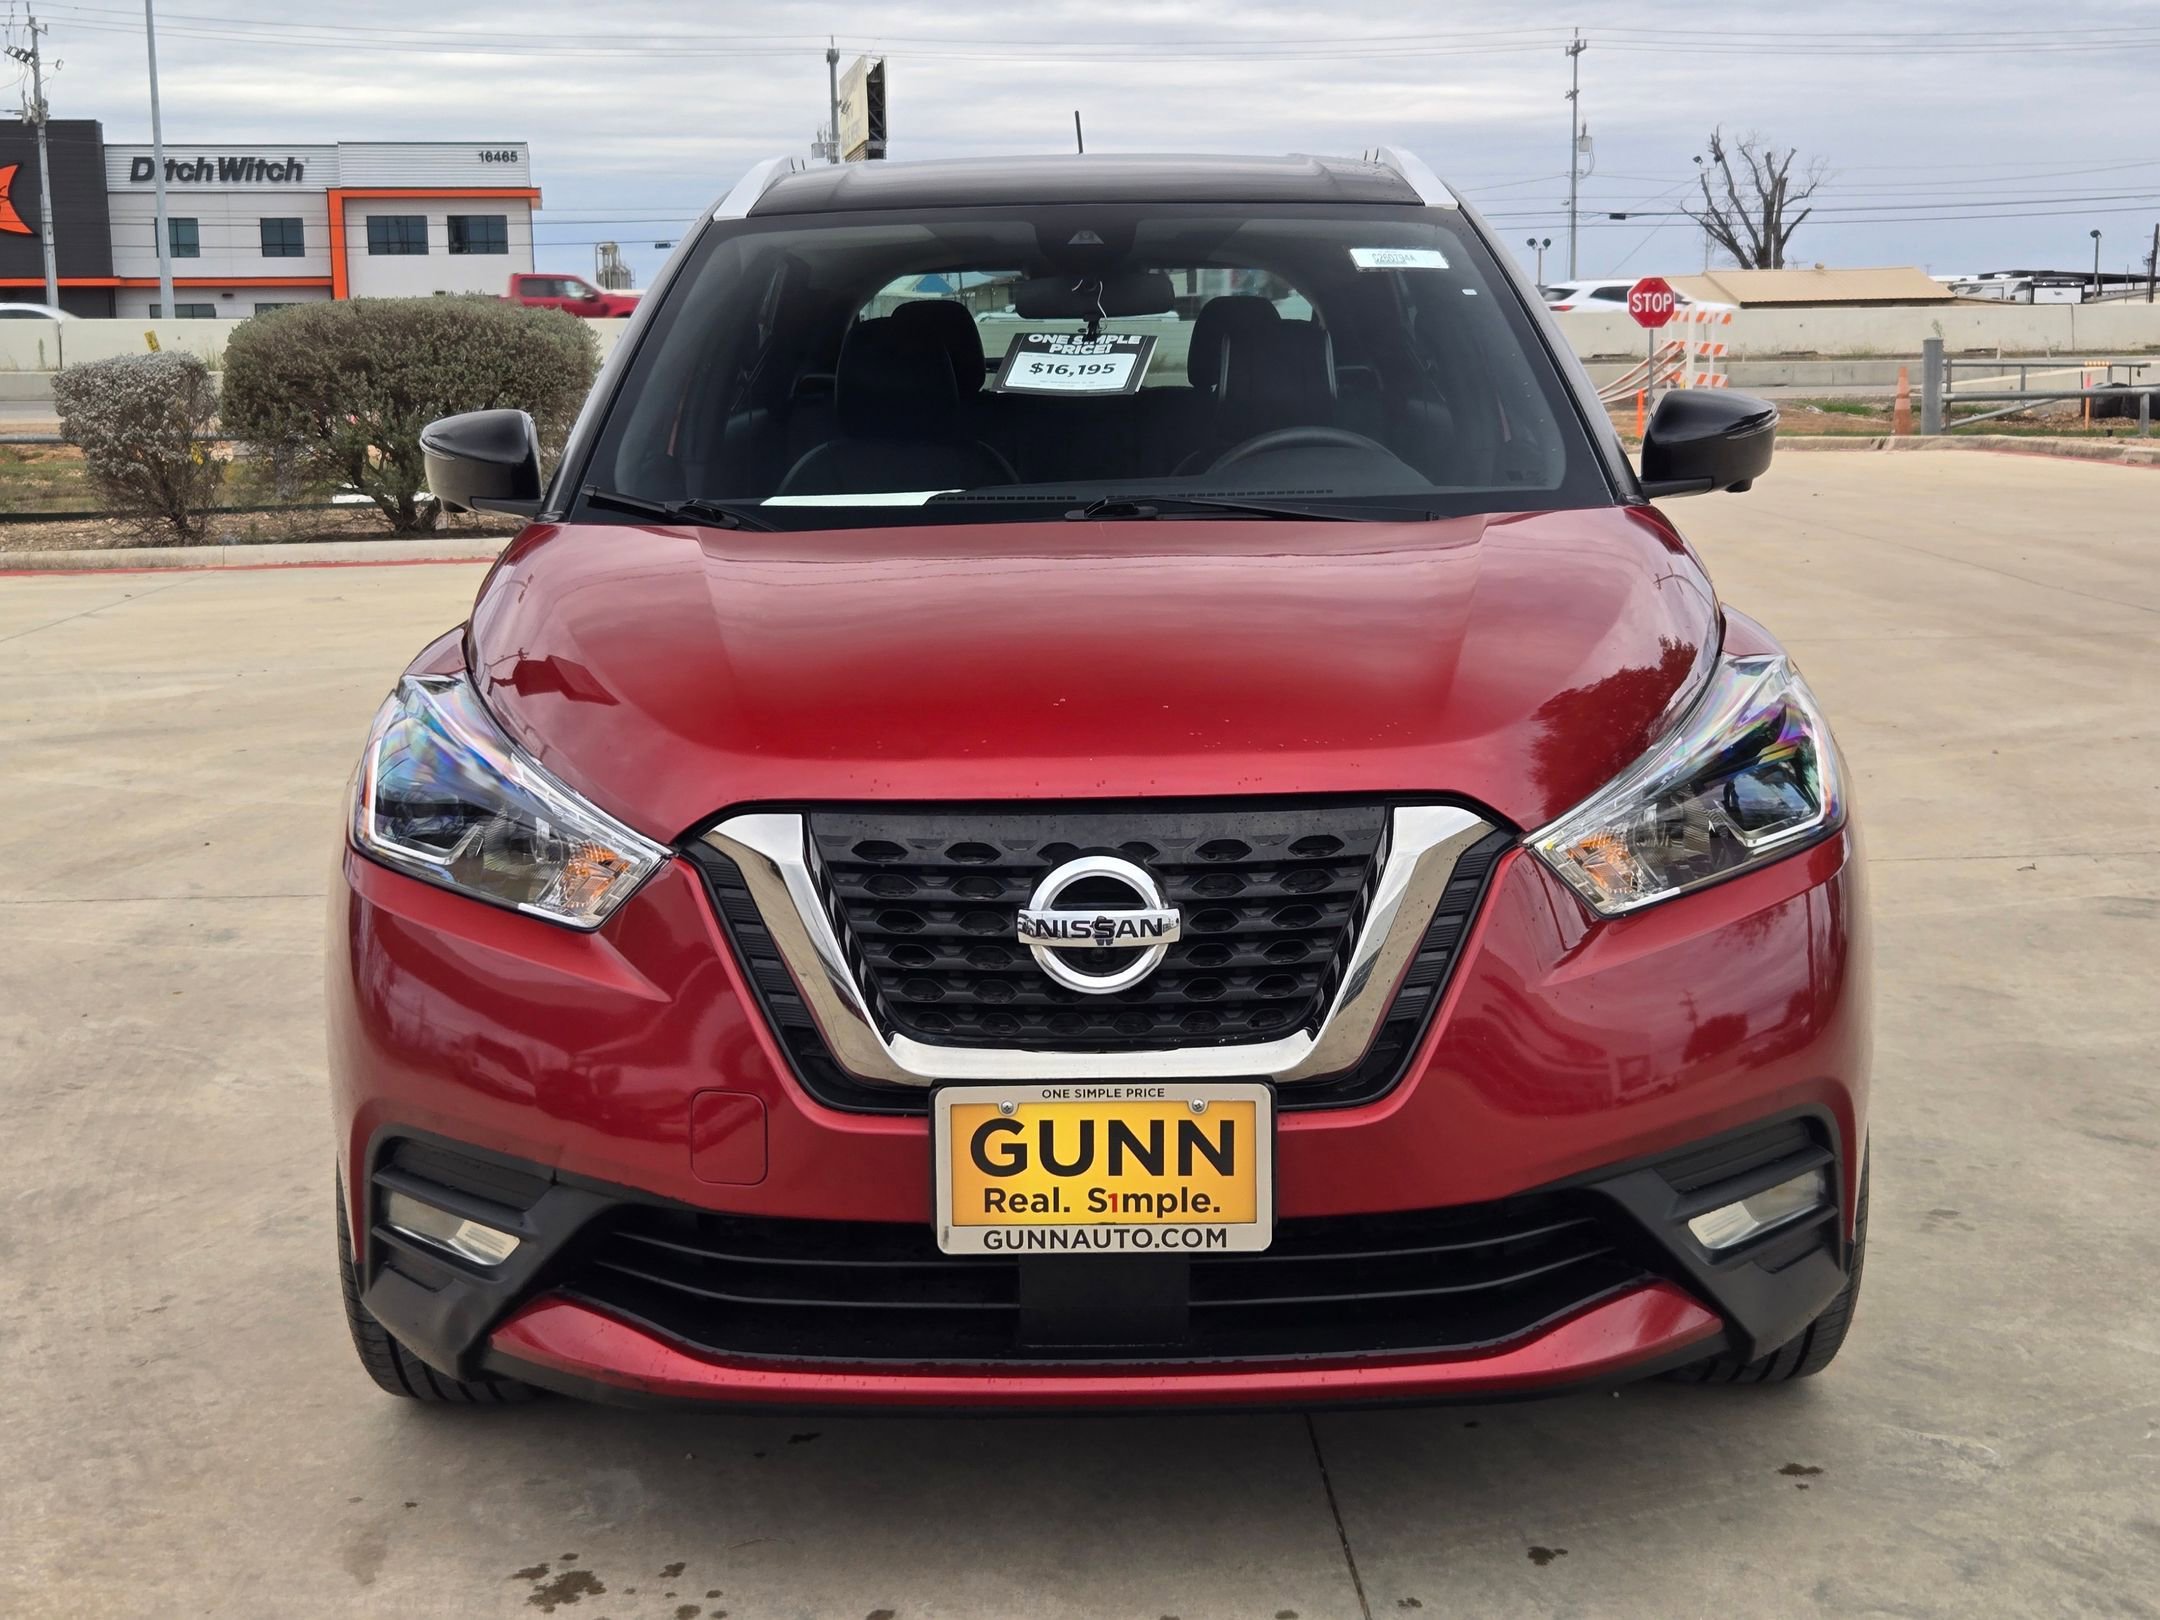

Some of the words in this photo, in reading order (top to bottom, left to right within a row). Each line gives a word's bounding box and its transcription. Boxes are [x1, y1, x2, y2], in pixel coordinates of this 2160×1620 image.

[478, 151, 518, 163] 16465
[130, 156, 214, 182] Dtch
[217, 156, 304, 182] Witch
[1631, 293, 1673, 313] STOP
[1028, 334, 1070, 345] ONE
[1049, 343, 1113, 354] PRICE!
[1029, 362, 1117, 377] $16,195
[1035, 918, 1163, 939] NISSAN
[1042, 1088, 1071, 1099] ONE
[1074, 1088, 1123, 1099] SIMPLE
[1126, 1087, 1165, 1098] PRICE
[970, 1118, 1235, 1177] GUNN
[984, 1187, 1071, 1213] Real.
[983, 1228, 1228, 1250] GUNNAUTO.COM
